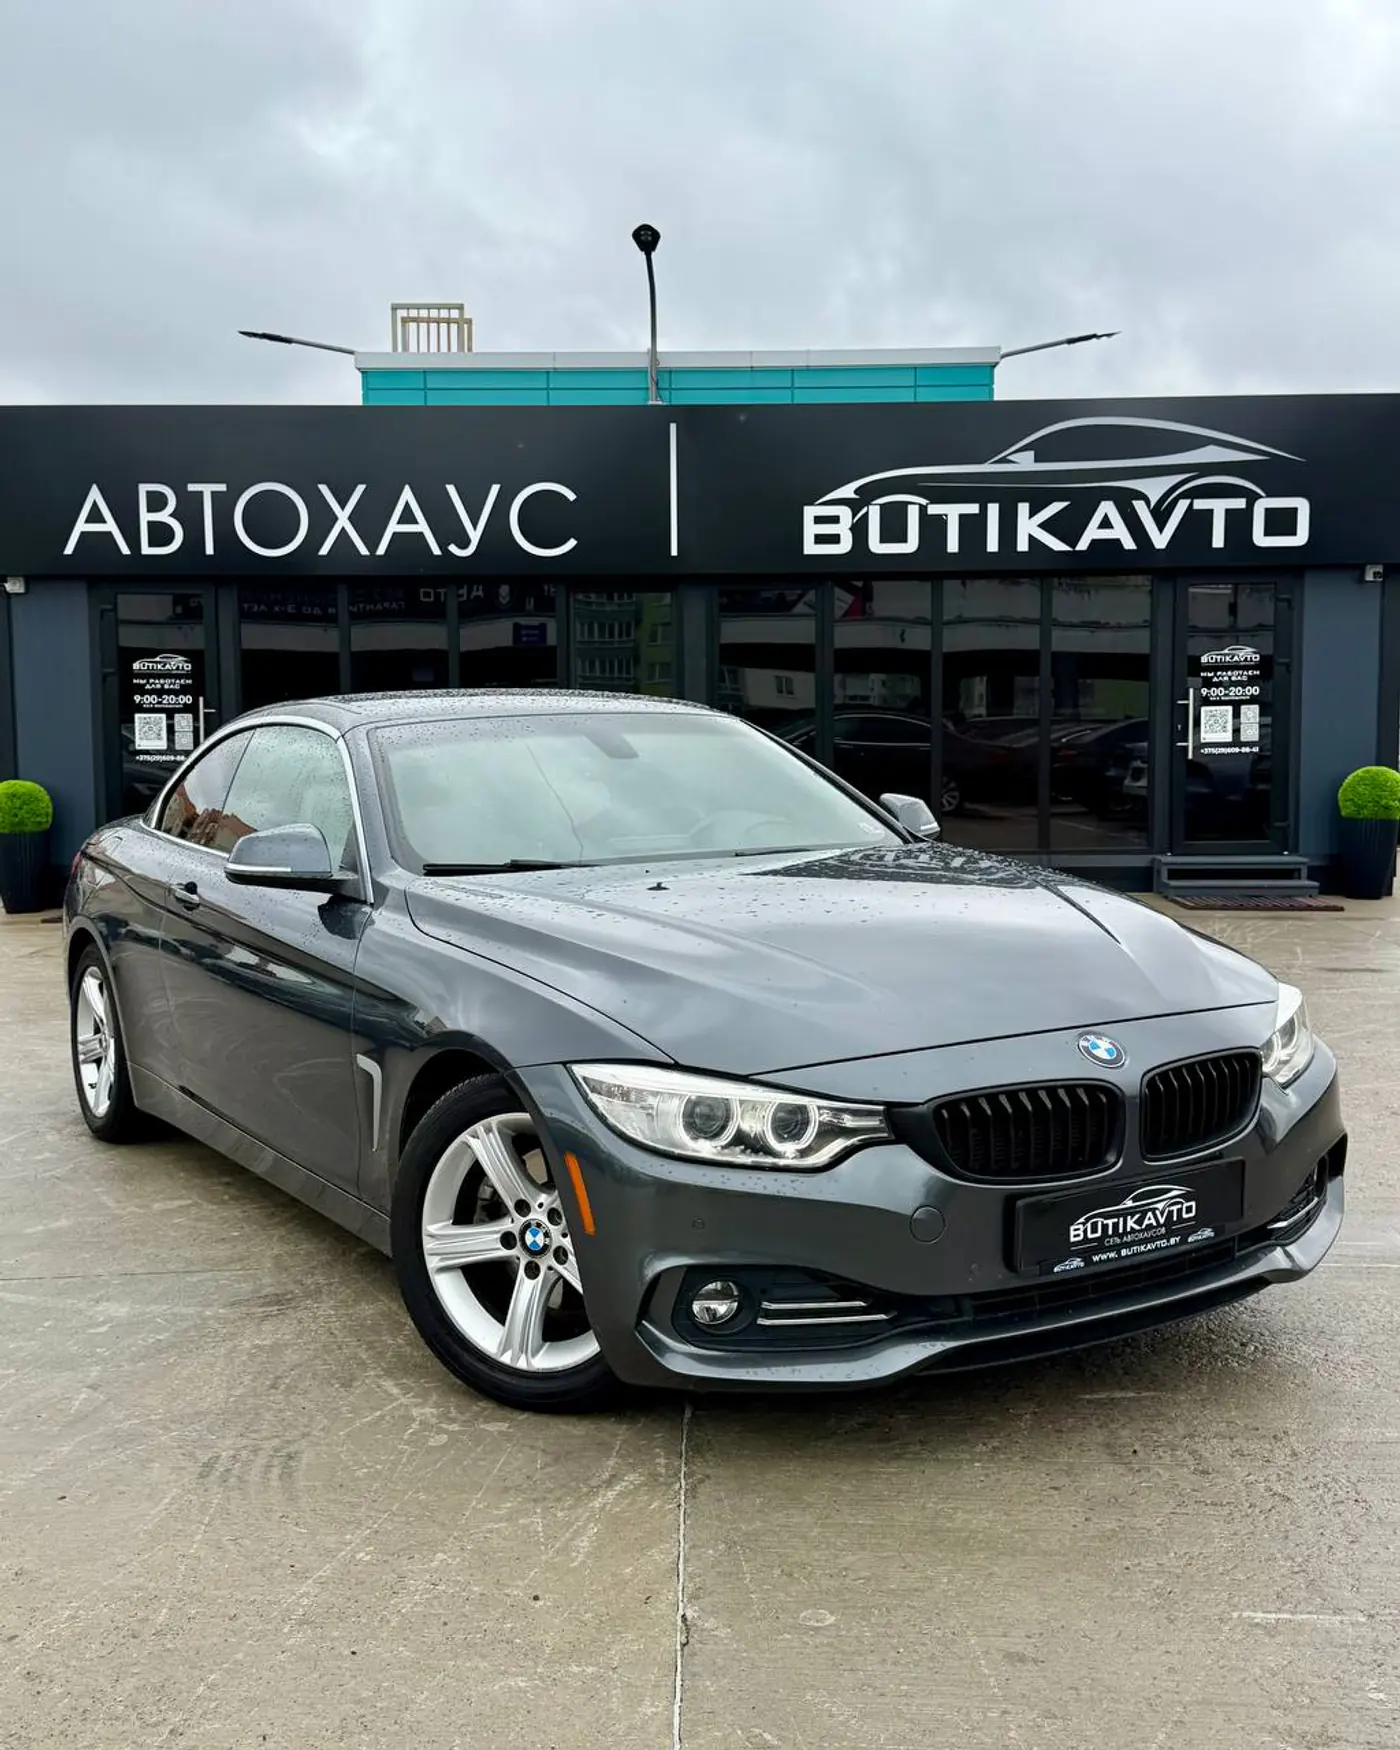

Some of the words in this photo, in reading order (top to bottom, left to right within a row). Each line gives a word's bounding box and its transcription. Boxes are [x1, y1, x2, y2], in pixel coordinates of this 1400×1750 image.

[63, 481, 578, 557] АВТОХАУС
[803, 496, 1310, 555] BUTIKAVTO
[133, 694, 193, 704] 9:00-20:00
[1200, 686, 1260, 697] 9:00-20:00
[1069, 1200, 1196, 1243] BUTIKAVTO
[1103, 1237, 1121, 1246] СЕТЬ
[1122, 1226, 1166, 1243] АВТОХАУСОВ
